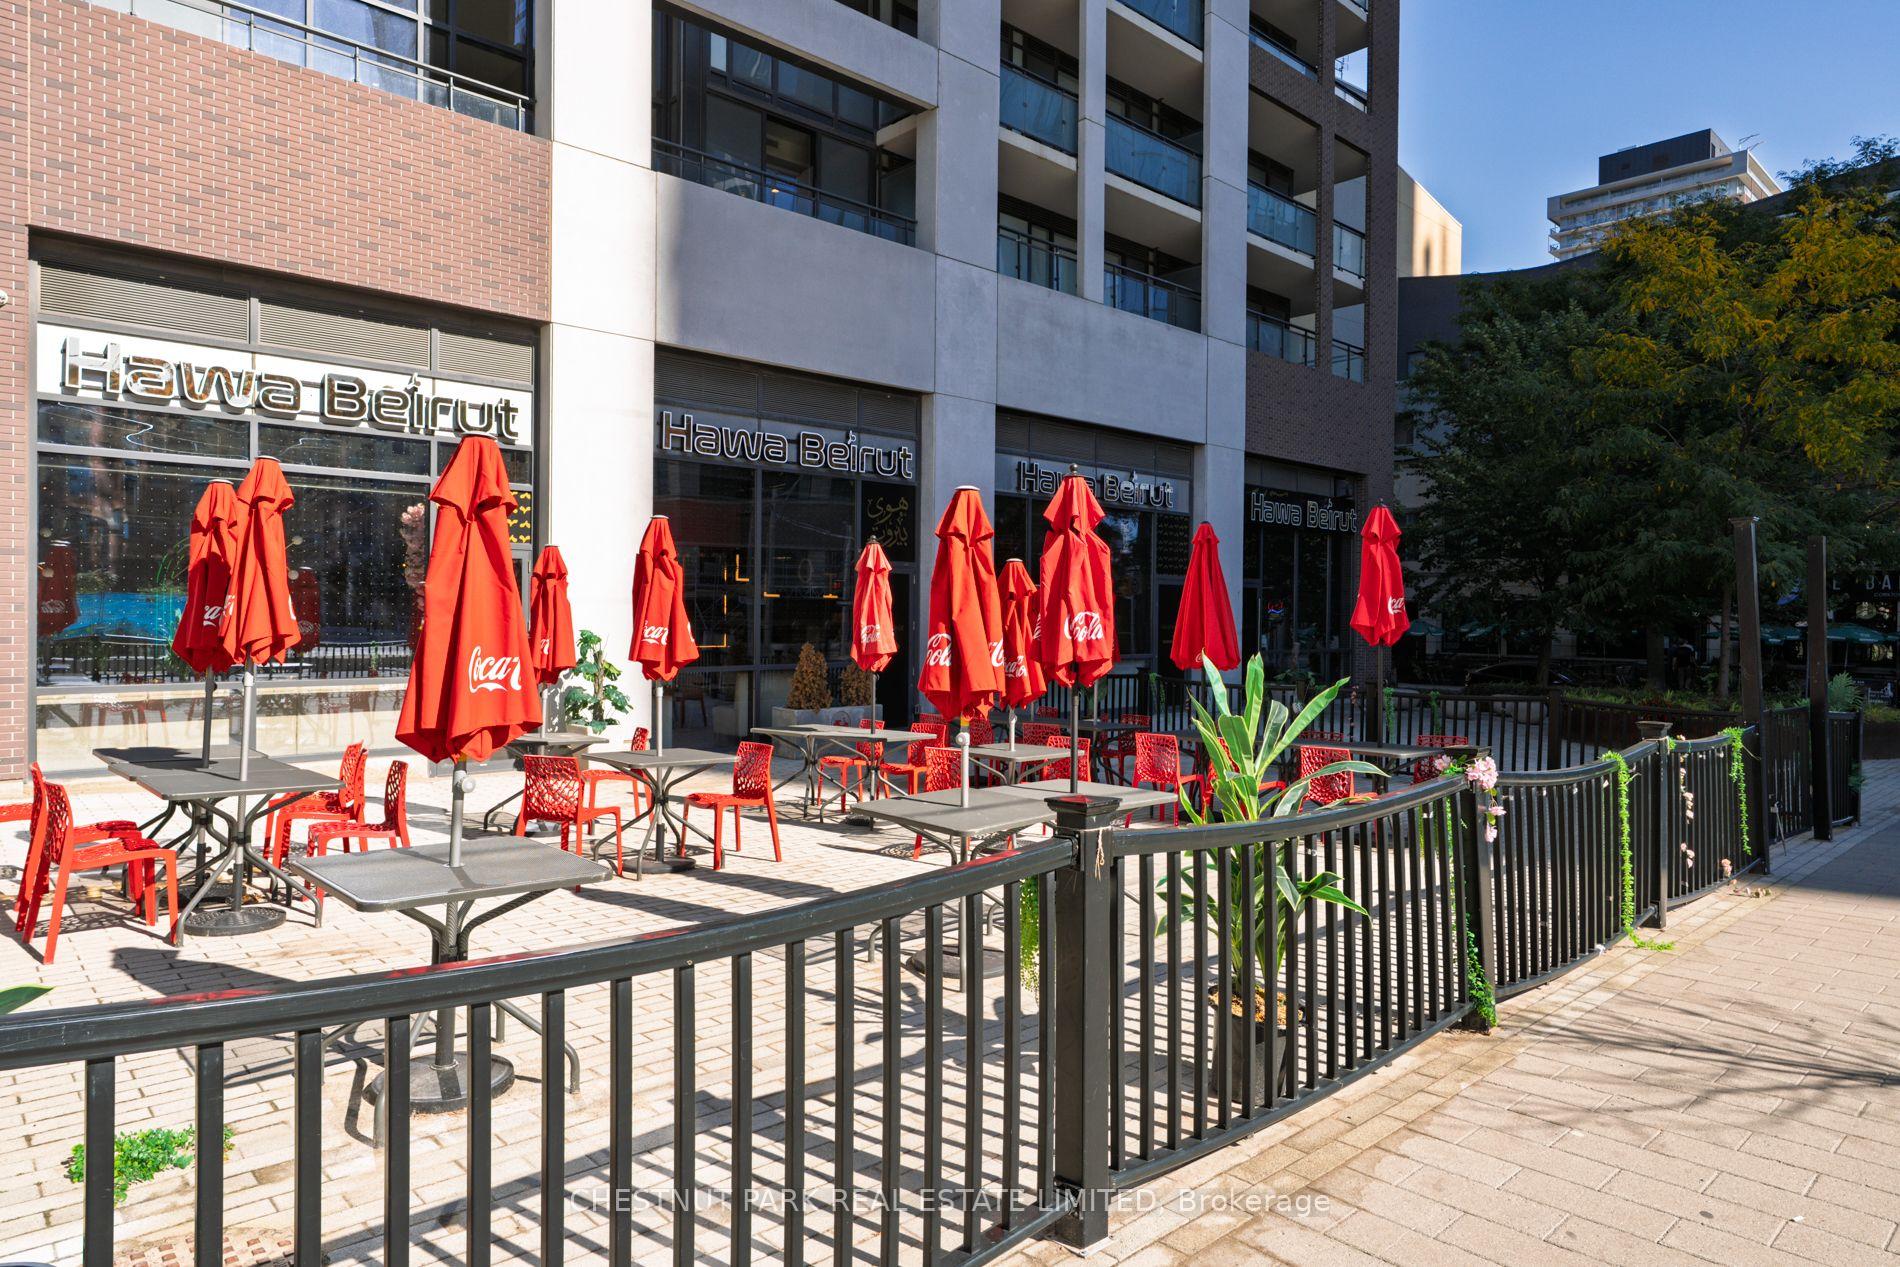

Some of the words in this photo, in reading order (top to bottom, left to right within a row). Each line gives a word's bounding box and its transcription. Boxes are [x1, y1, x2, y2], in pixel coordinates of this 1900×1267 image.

[63, 336, 301, 415] Hawa
[324, 371, 519, 438] Beirut
[662, 411, 788, 463] Hawa
[800, 430, 913, 479] Beirut
[1019, 460, 1097, 498] Haa
[1103, 469, 1174, 508] Beirut
[1251, 492, 1302, 526] Hawa
[1307, 498, 1357, 532] Beirut
